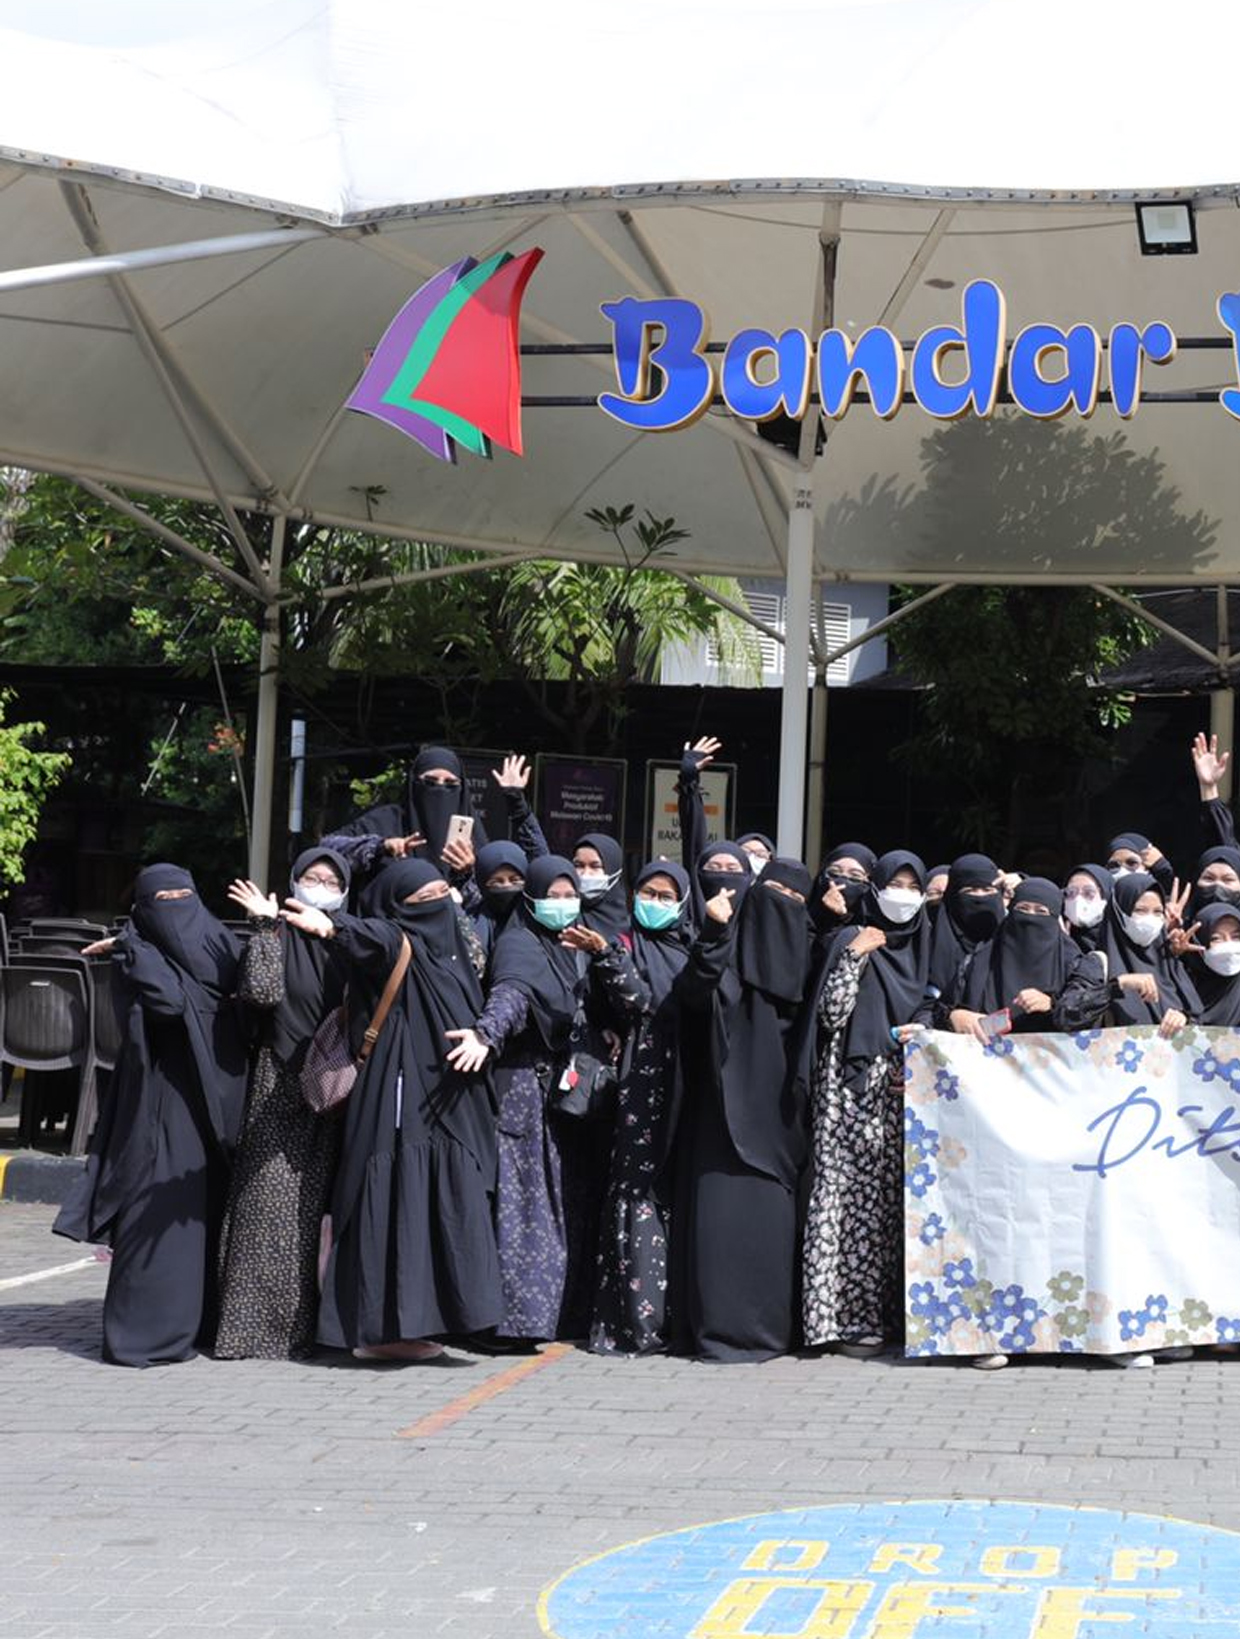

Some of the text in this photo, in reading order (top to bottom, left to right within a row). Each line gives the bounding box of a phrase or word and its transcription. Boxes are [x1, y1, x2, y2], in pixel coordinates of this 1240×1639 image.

[597, 277, 1178, 433] Bandar
[740, 1538, 1181, 1582] DROP
[684, 1575, 1186, 1639] OFF
